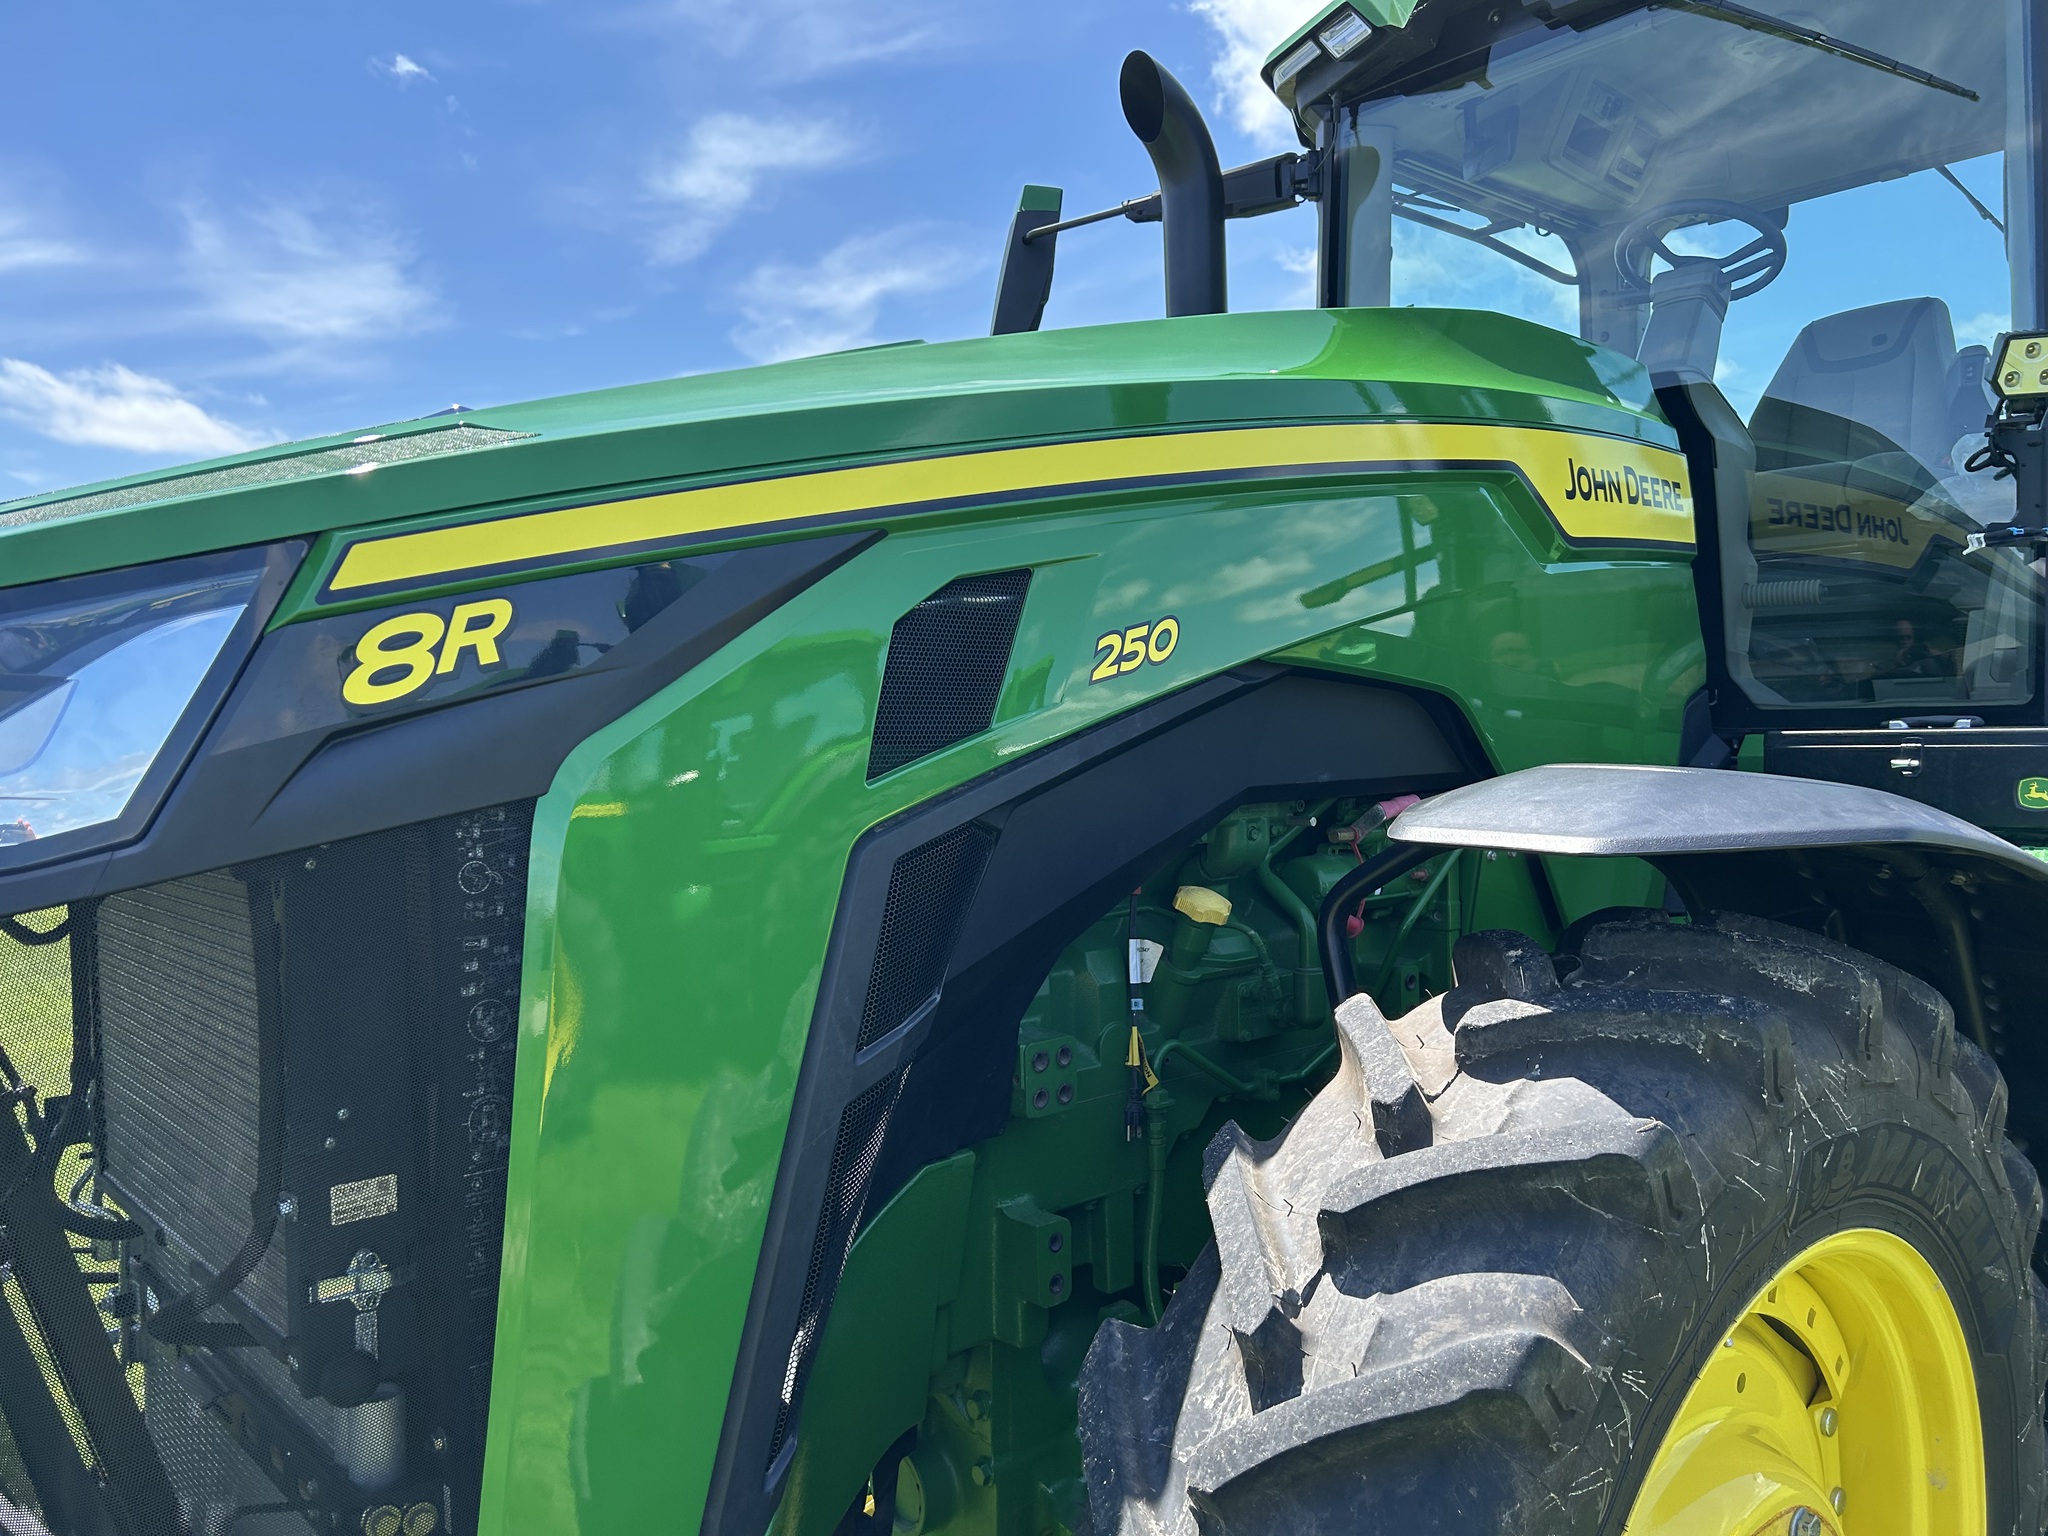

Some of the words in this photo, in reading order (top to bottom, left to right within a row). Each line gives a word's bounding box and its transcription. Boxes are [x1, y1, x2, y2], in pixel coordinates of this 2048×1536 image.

[1565, 457, 1623, 503] JOHN
[1623, 465, 1684, 512] DEERE
[342, 598, 513, 705] 8R
[1090, 616, 1180, 684] 250
[1855, 1127, 2016, 1319] MICHELIN
